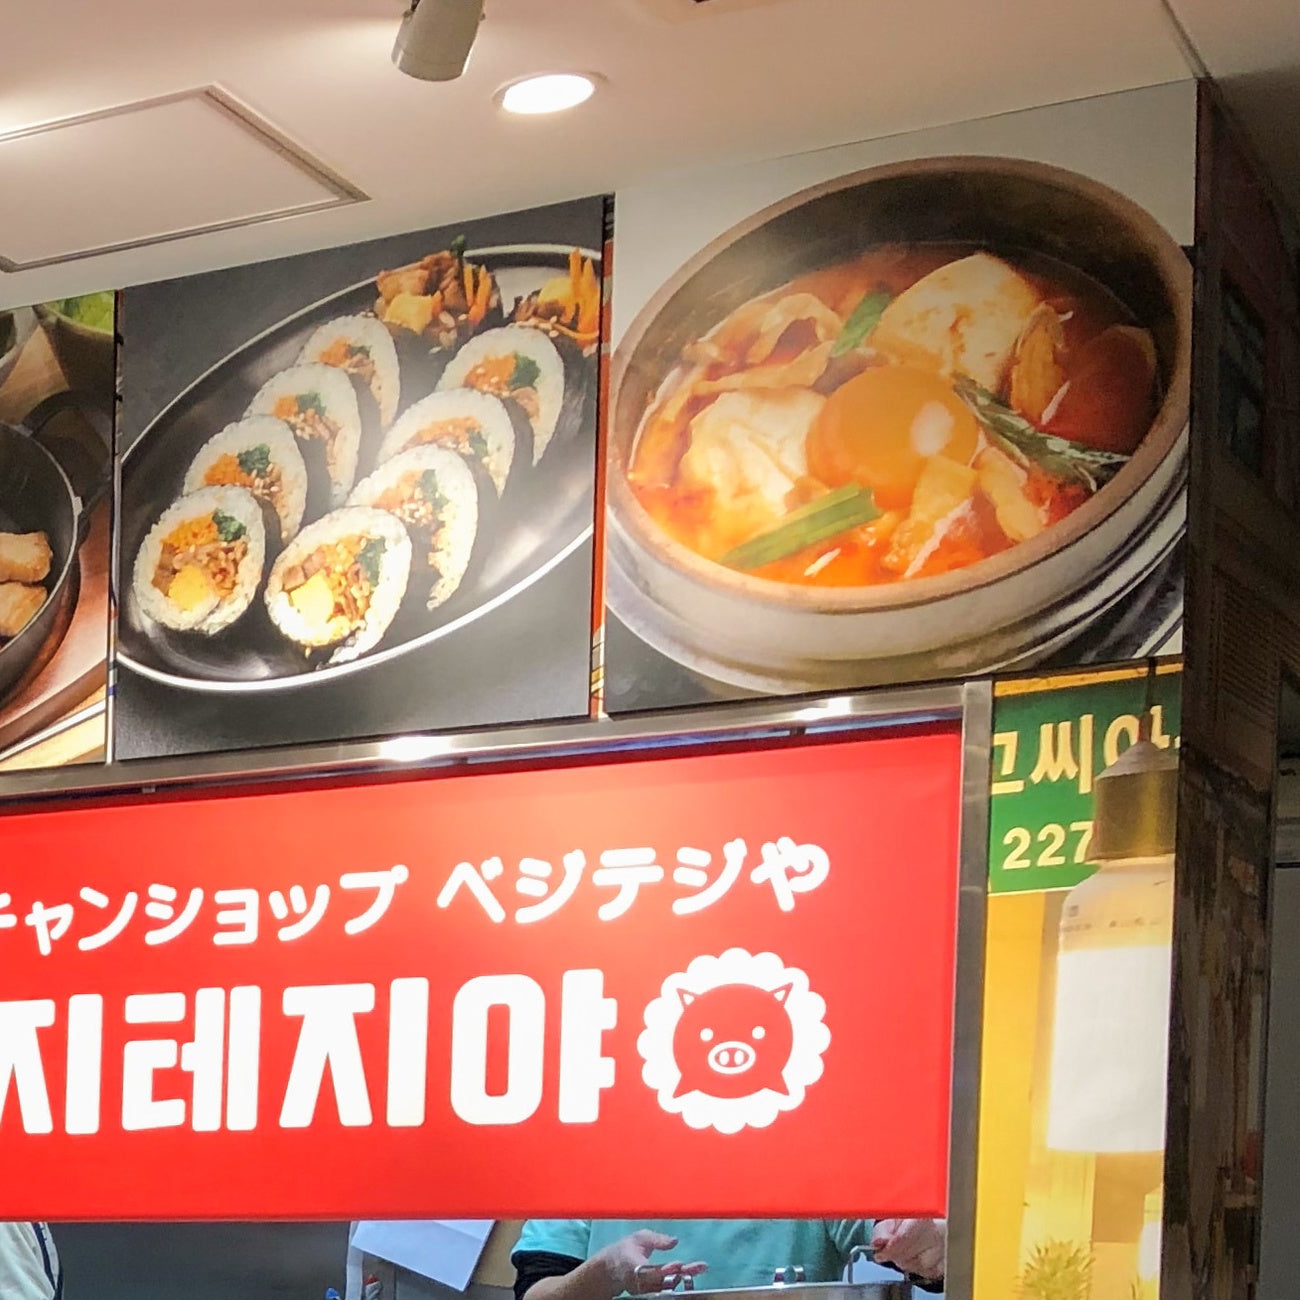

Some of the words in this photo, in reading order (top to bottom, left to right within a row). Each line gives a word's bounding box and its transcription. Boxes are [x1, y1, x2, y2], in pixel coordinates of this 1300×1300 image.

[437, 835, 830, 924] ベジテジや
